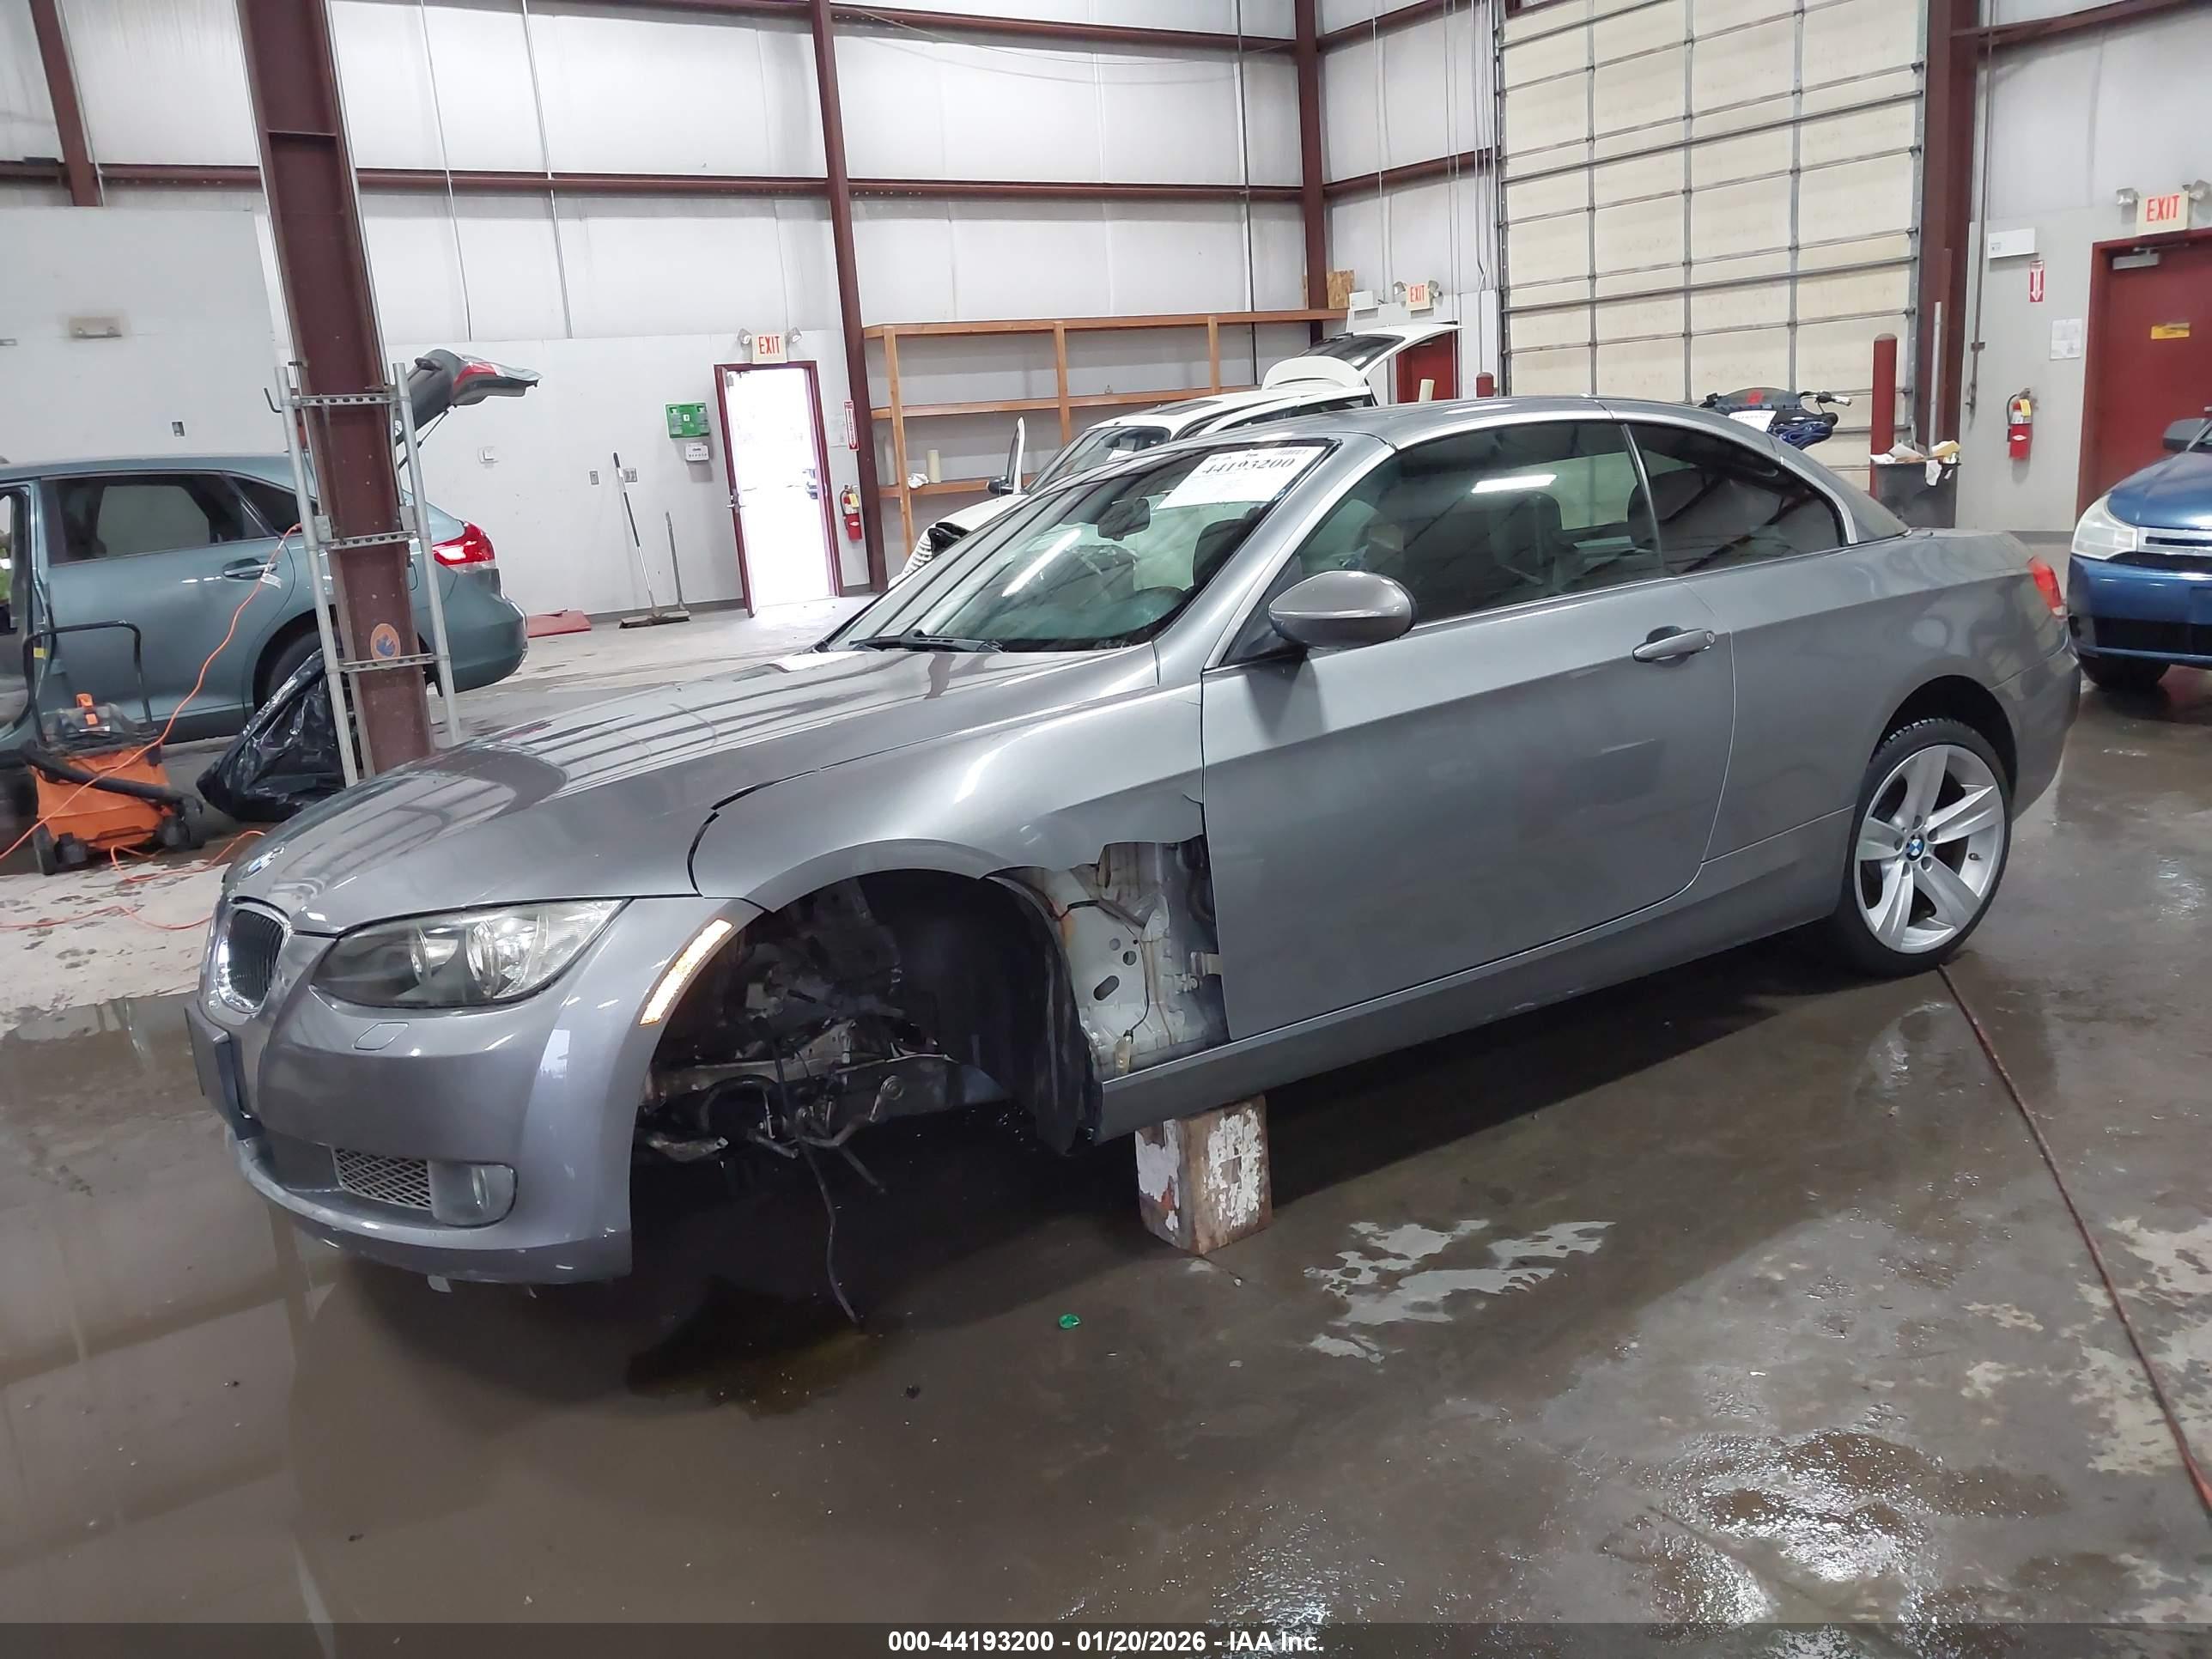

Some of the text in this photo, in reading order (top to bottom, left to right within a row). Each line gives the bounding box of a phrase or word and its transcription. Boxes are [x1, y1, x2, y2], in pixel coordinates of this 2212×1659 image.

[2147, 194, 2179, 222] EXIT
[1410, 284, 1425, 302] EXIT
[758, 336, 780, 354] EXIT
